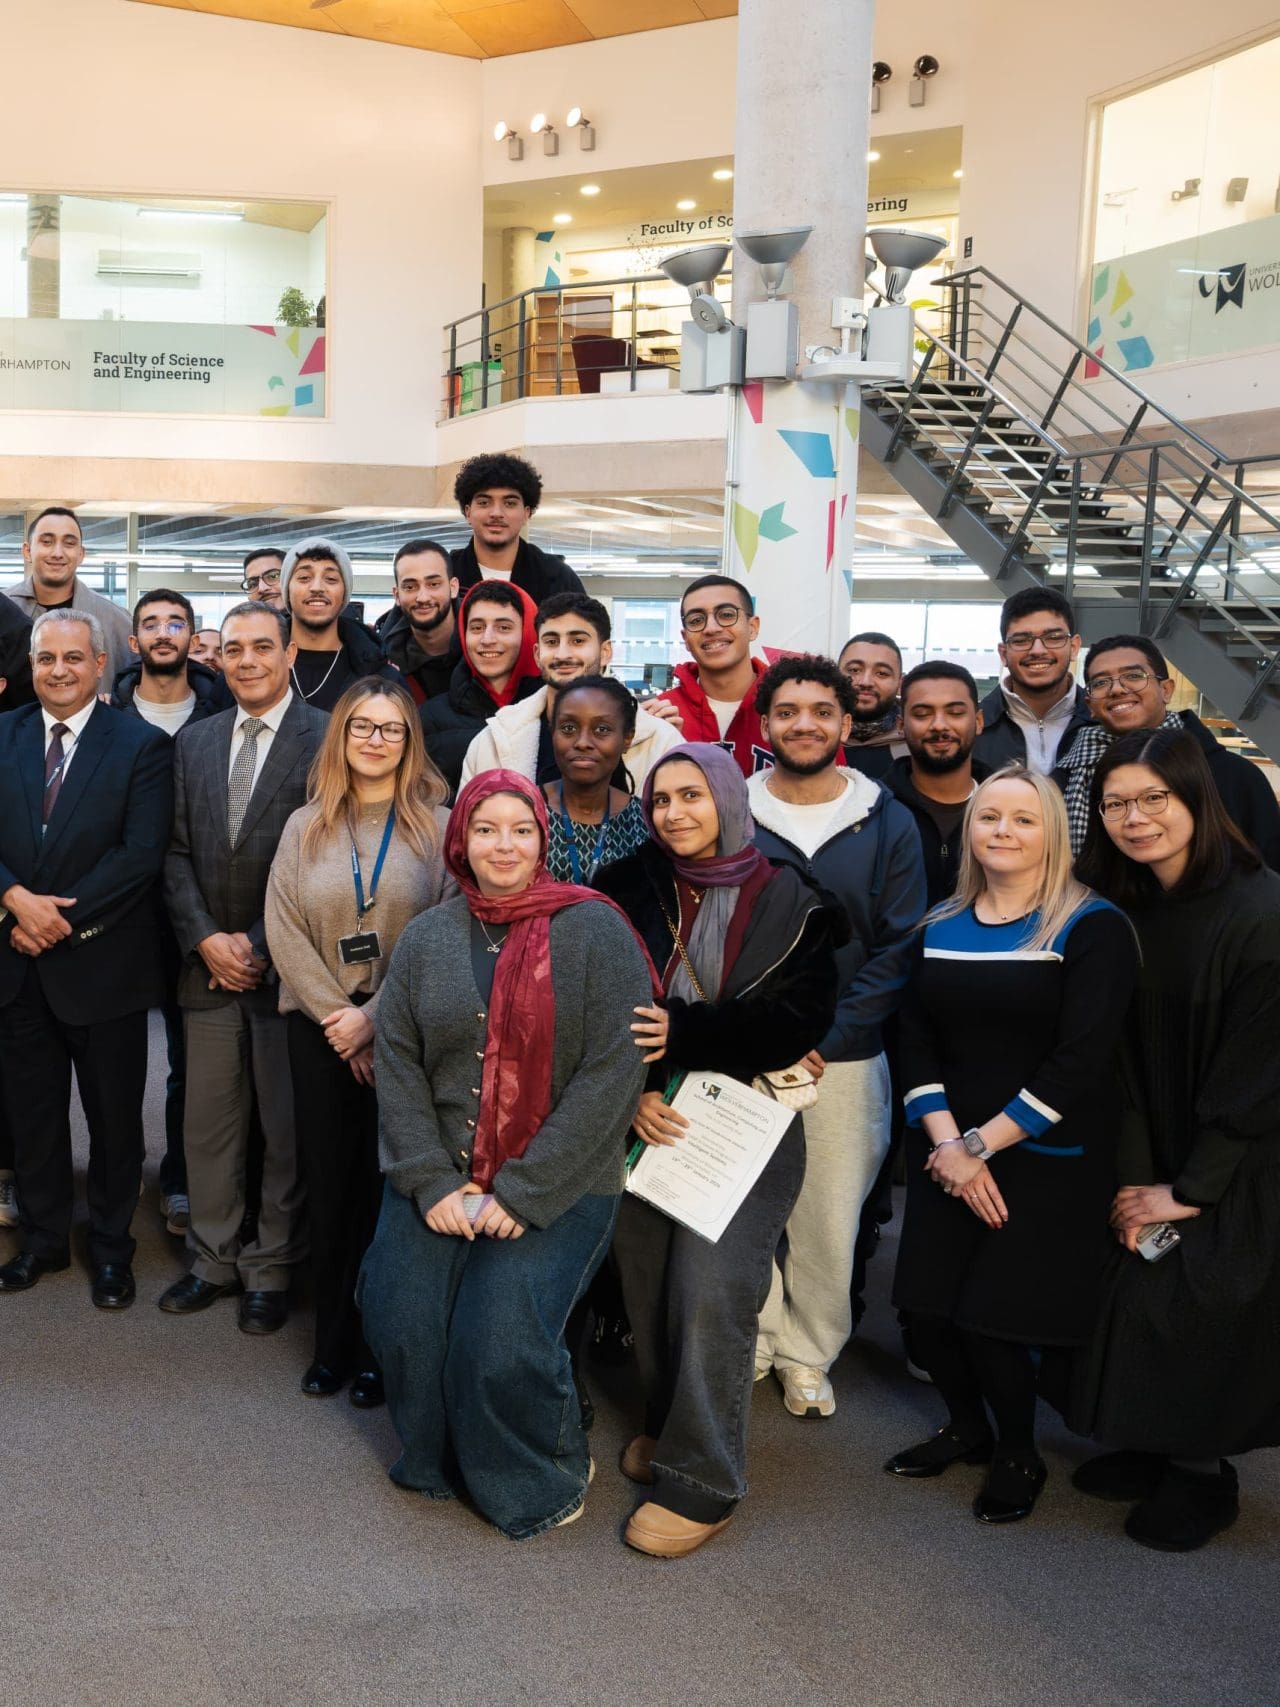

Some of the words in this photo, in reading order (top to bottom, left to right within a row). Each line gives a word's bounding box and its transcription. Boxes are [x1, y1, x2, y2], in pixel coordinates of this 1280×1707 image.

[640, 219, 695, 236] Faculty
[698, 216, 714, 229] of
[93, 351, 147, 367] Faculty
[151, 353, 166, 366] of
[168, 353, 225, 367] Science
[93, 366, 120, 378] and
[124, 366, 211, 384] Engineering
